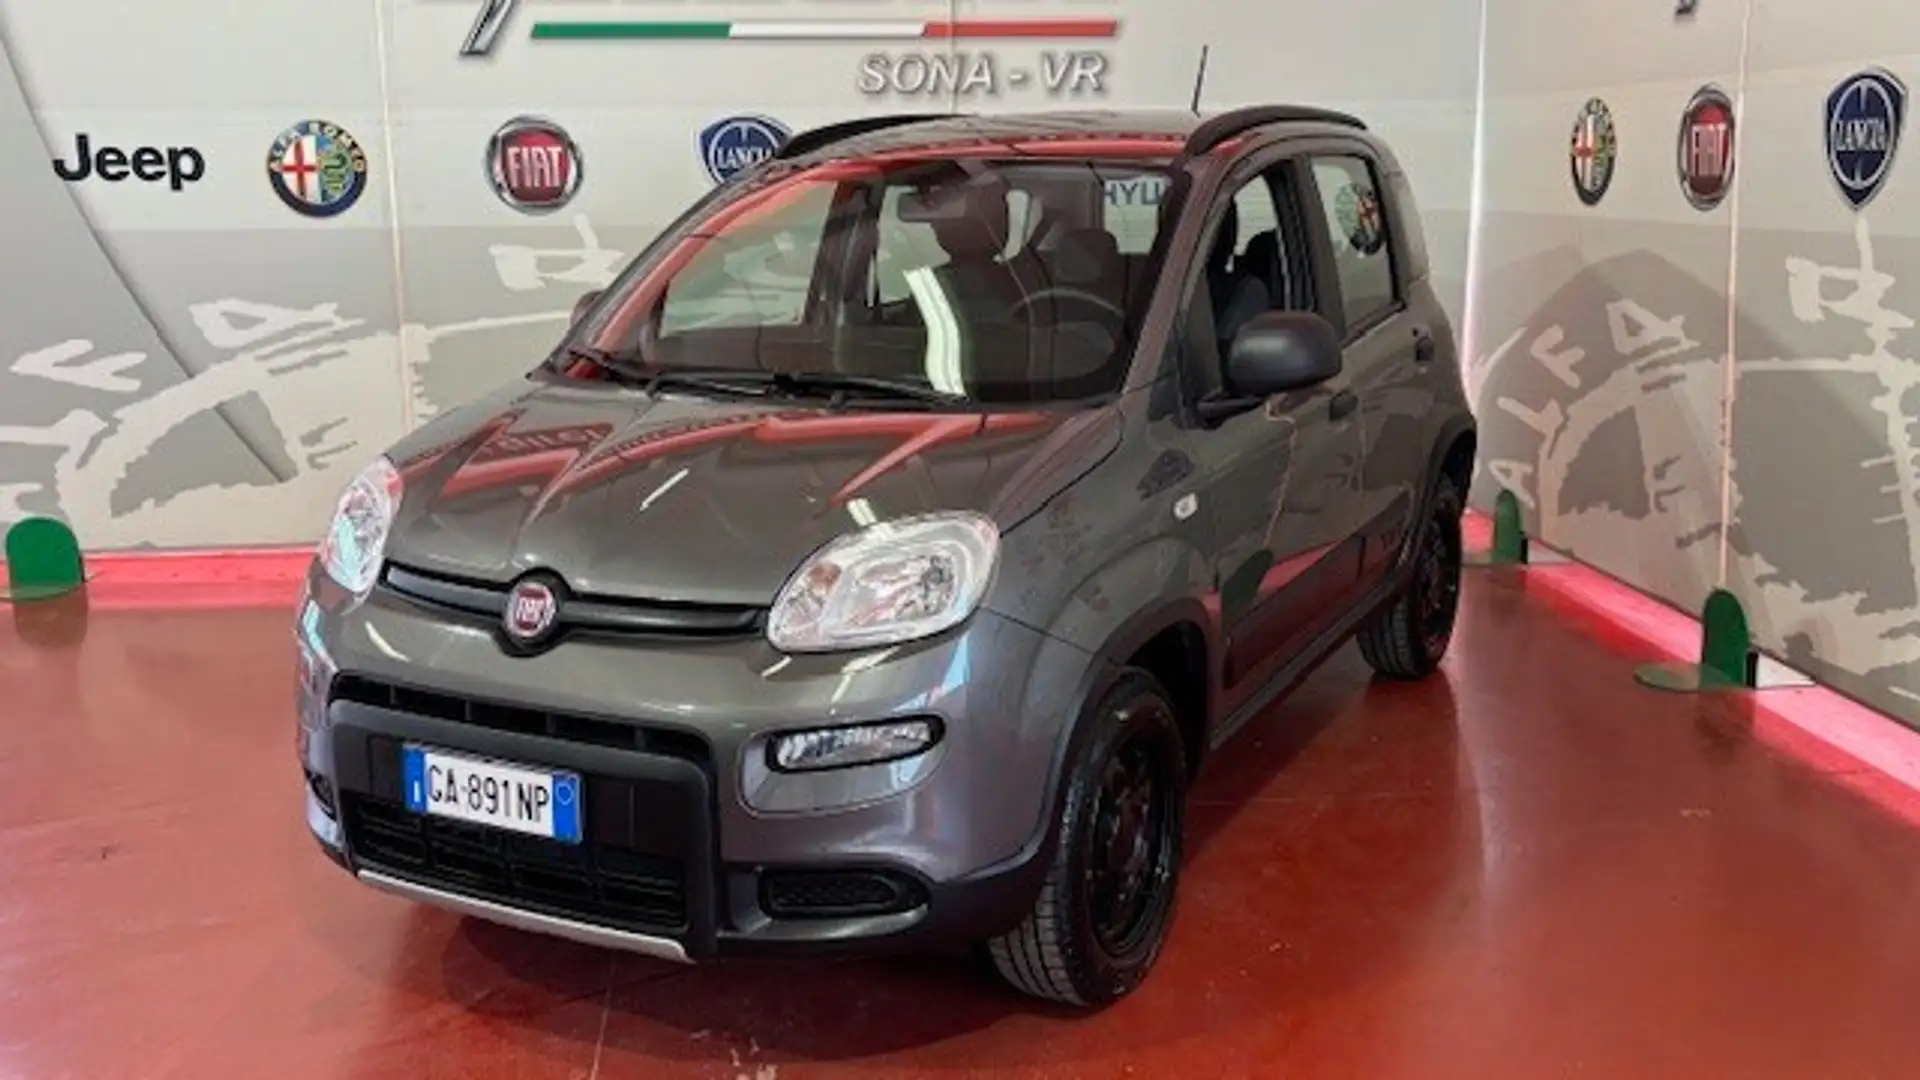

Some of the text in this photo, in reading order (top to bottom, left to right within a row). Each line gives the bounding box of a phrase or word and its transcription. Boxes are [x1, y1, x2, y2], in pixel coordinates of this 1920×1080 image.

[858, 52, 997, 96] SONA
[1042, 51, 1109, 94] VR
[52, 133, 205, 191] Jeep
[506, 146, 563, 188] FIAT
